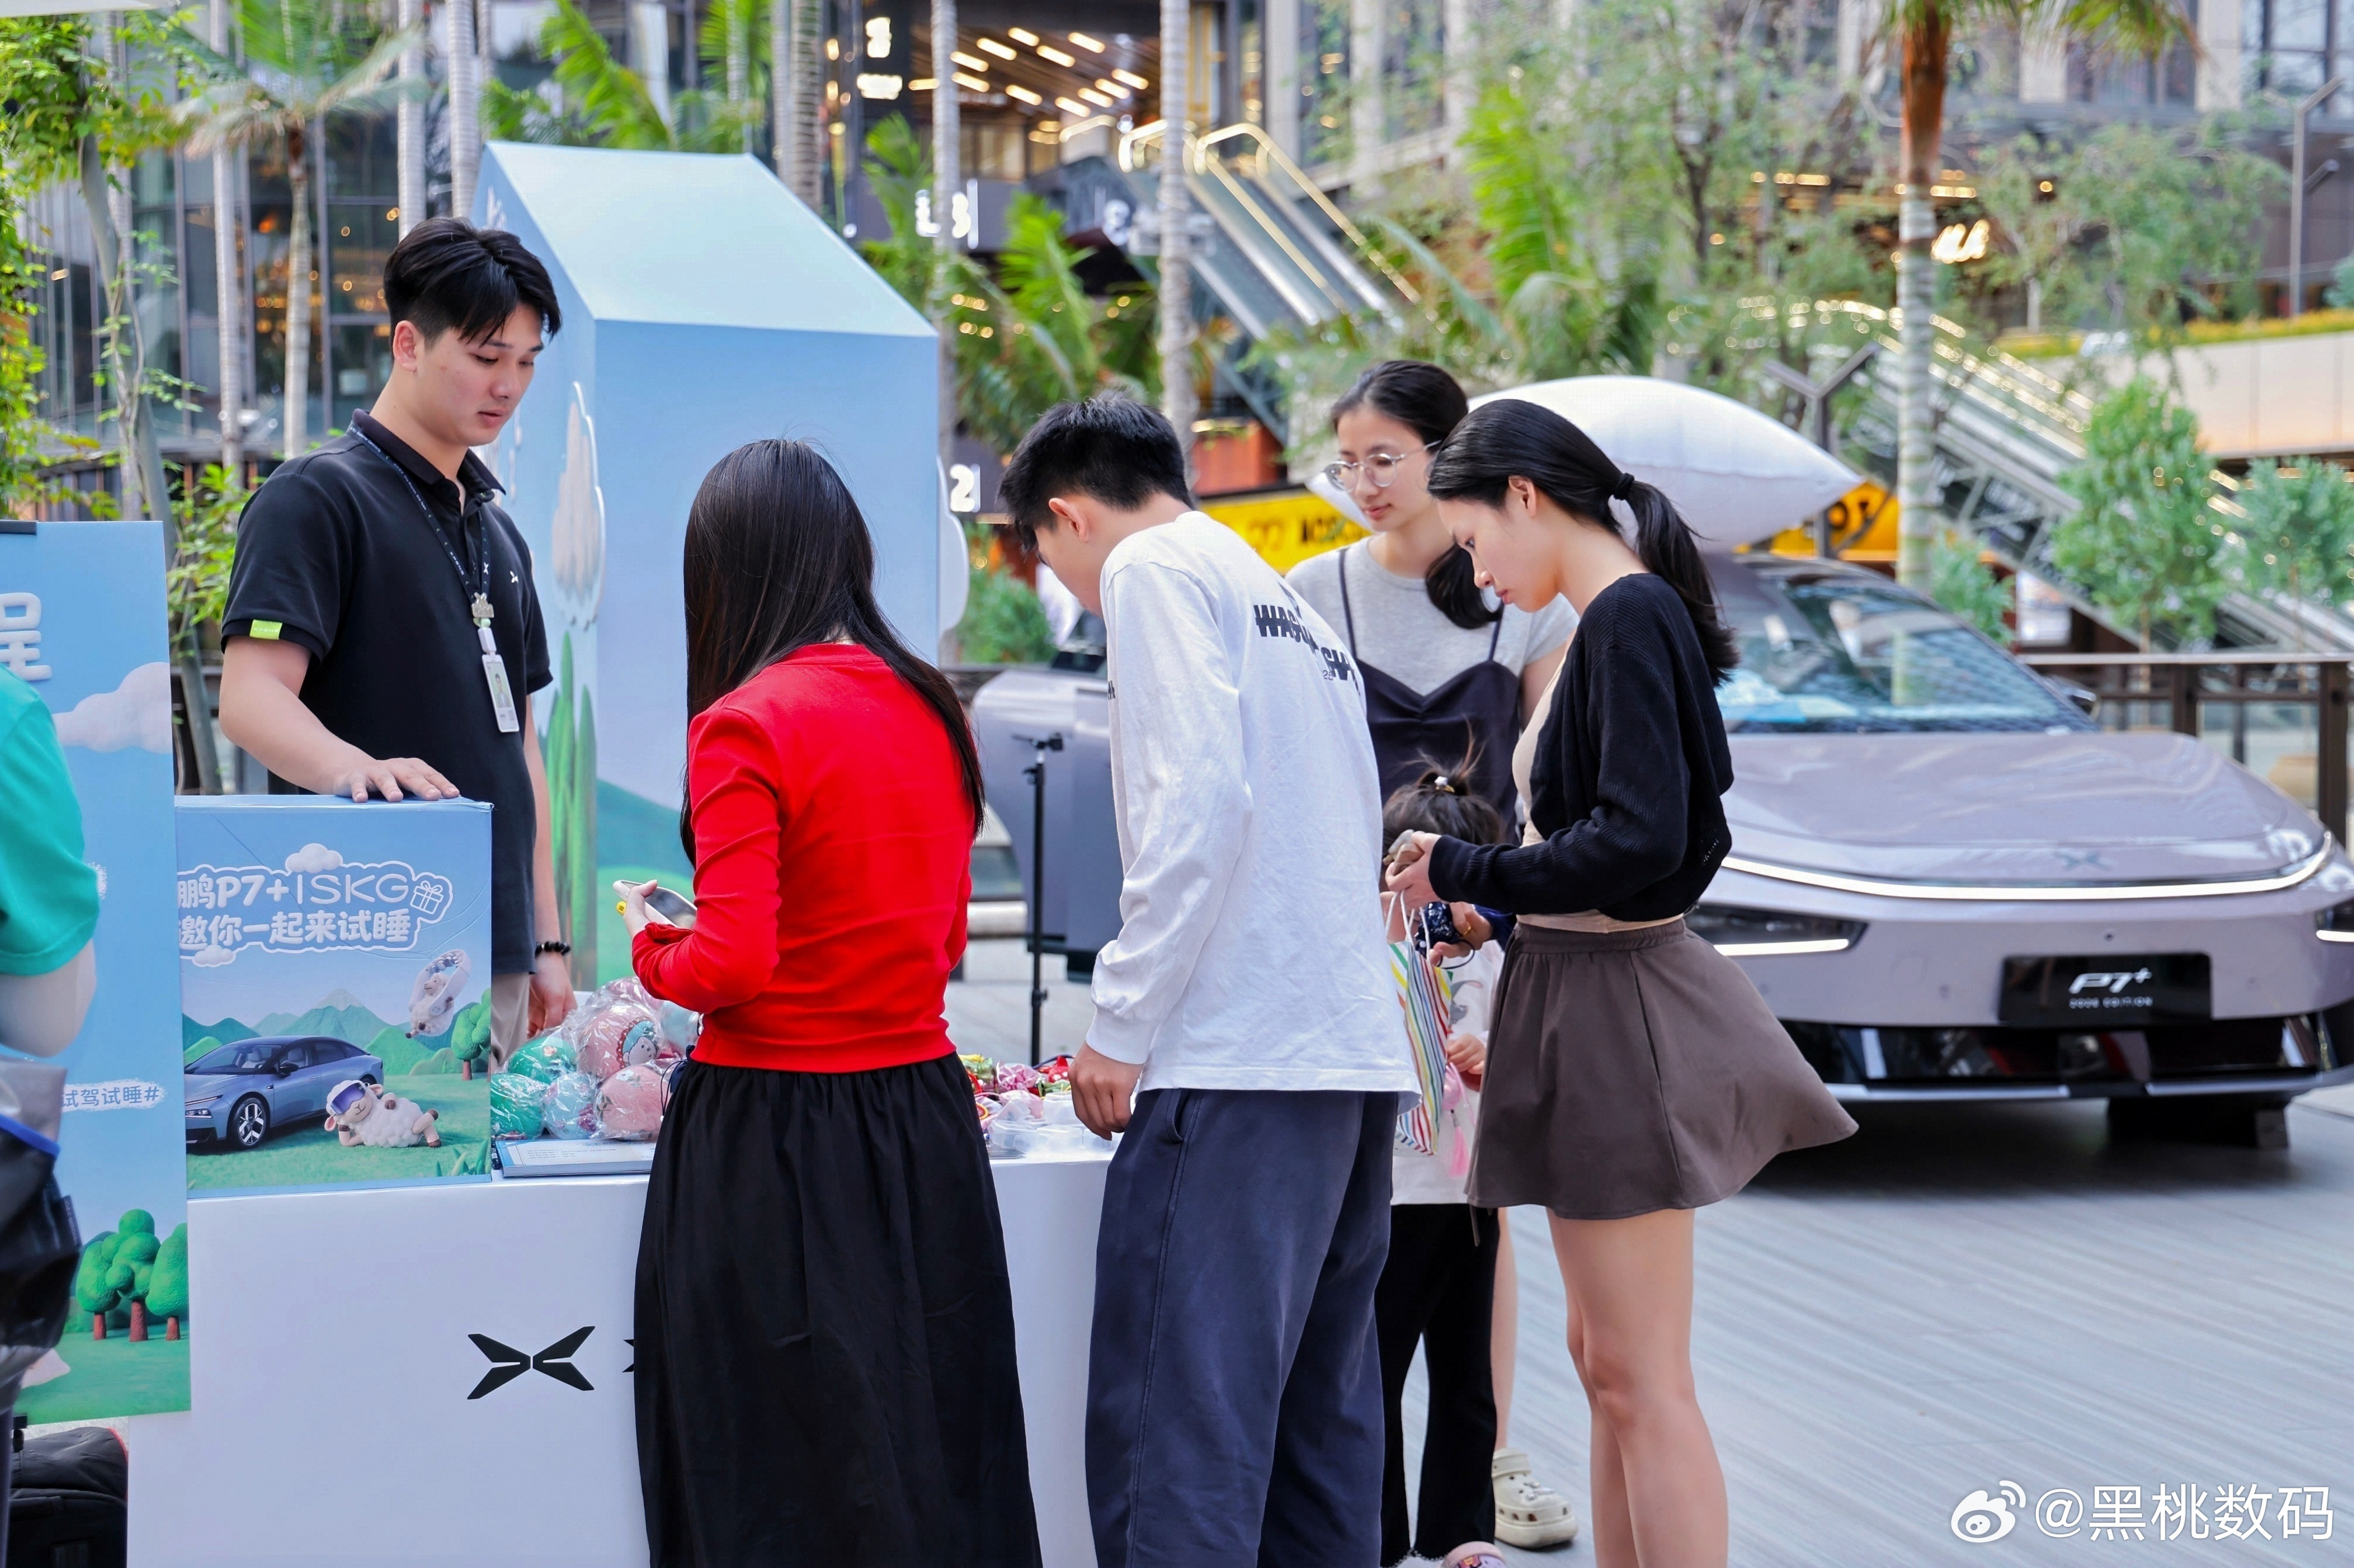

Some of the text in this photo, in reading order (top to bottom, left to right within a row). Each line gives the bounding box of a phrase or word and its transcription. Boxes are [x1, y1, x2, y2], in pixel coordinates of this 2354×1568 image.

[178, 908, 411, 951] 邀你一起来试睡
[2068, 967, 2153, 994] P7+
